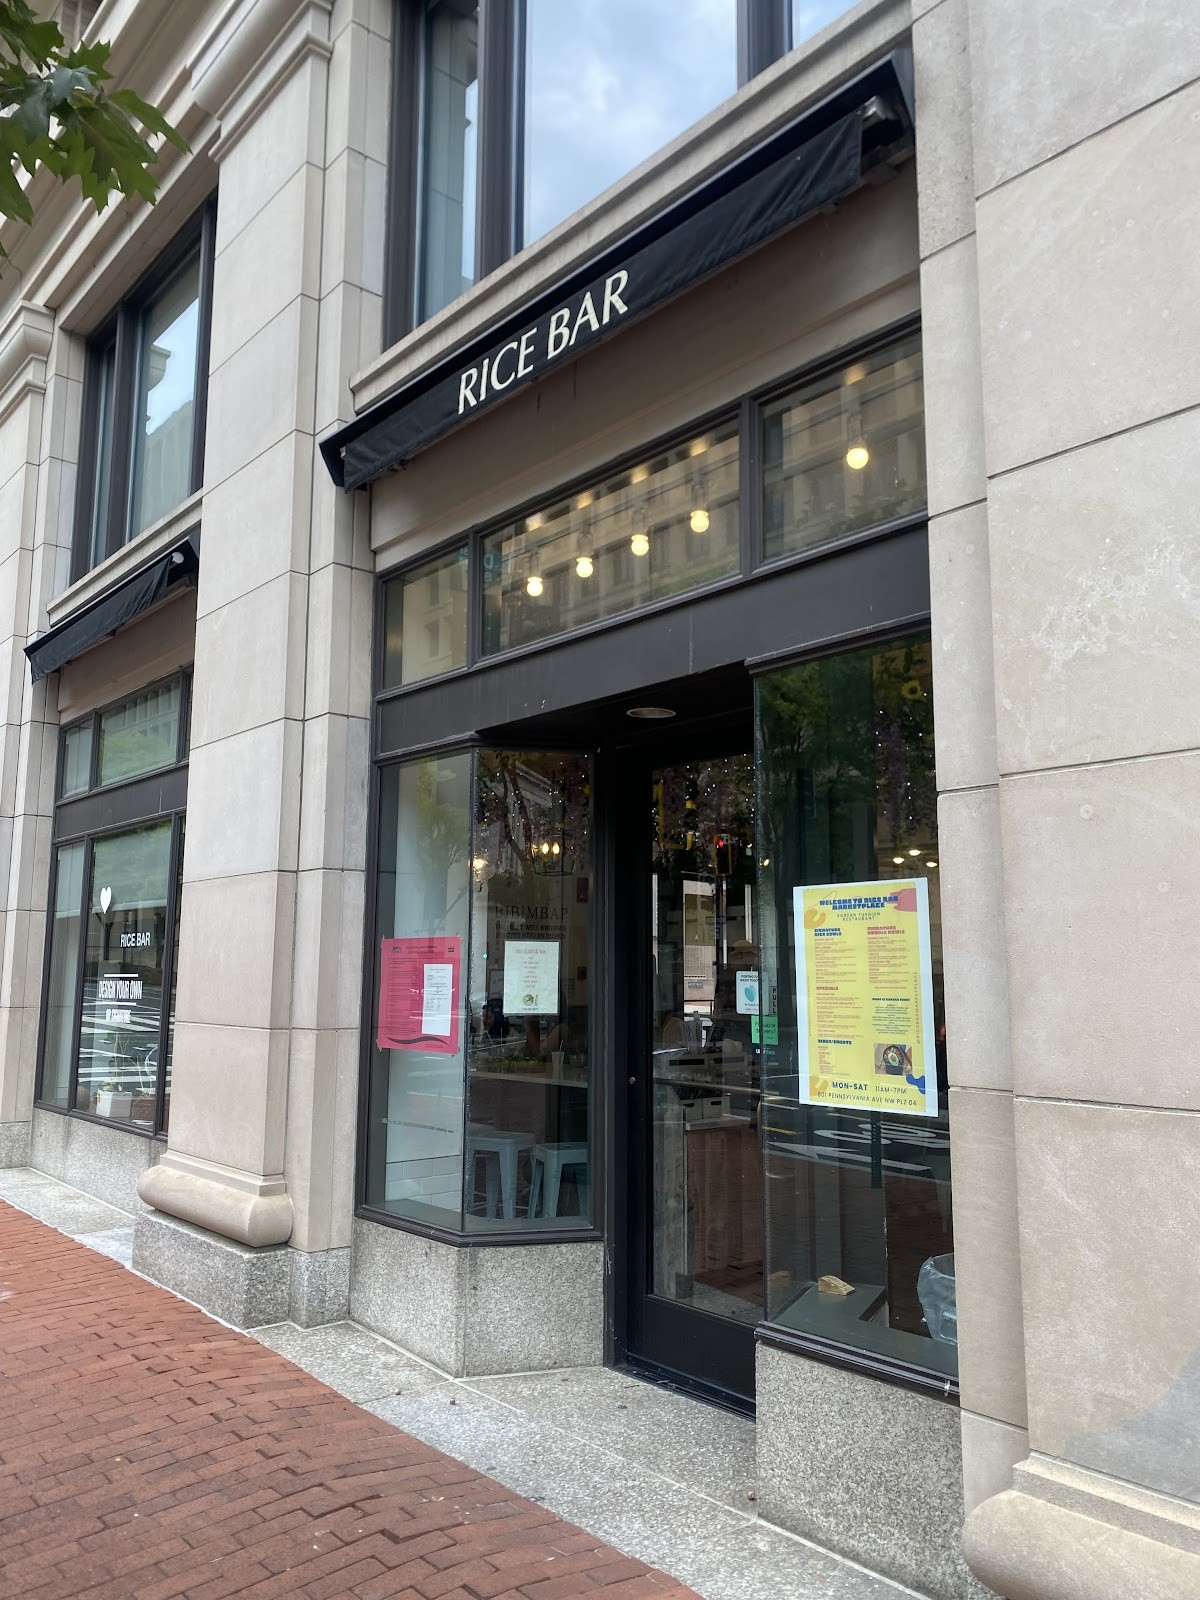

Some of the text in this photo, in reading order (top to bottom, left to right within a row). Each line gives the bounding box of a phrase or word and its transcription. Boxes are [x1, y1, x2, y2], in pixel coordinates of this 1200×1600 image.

[458, 269, 629, 415] RICE BAR
[820, 898, 852, 906] WELCOME
[883, 895, 899, 903] BAR
[832, 902, 885, 910] MARKETPLACE
[495, 905, 568, 920] BIBIMBAP
[121, 932, 151, 948] RICE BAR
[99, 981, 143, 999] DESIGN YOUR OWN
[832, 1081, 907, 1094] MON-SAT 11AM-7PM
[828, 1092, 870, 1102] PENNSYLVANIA
